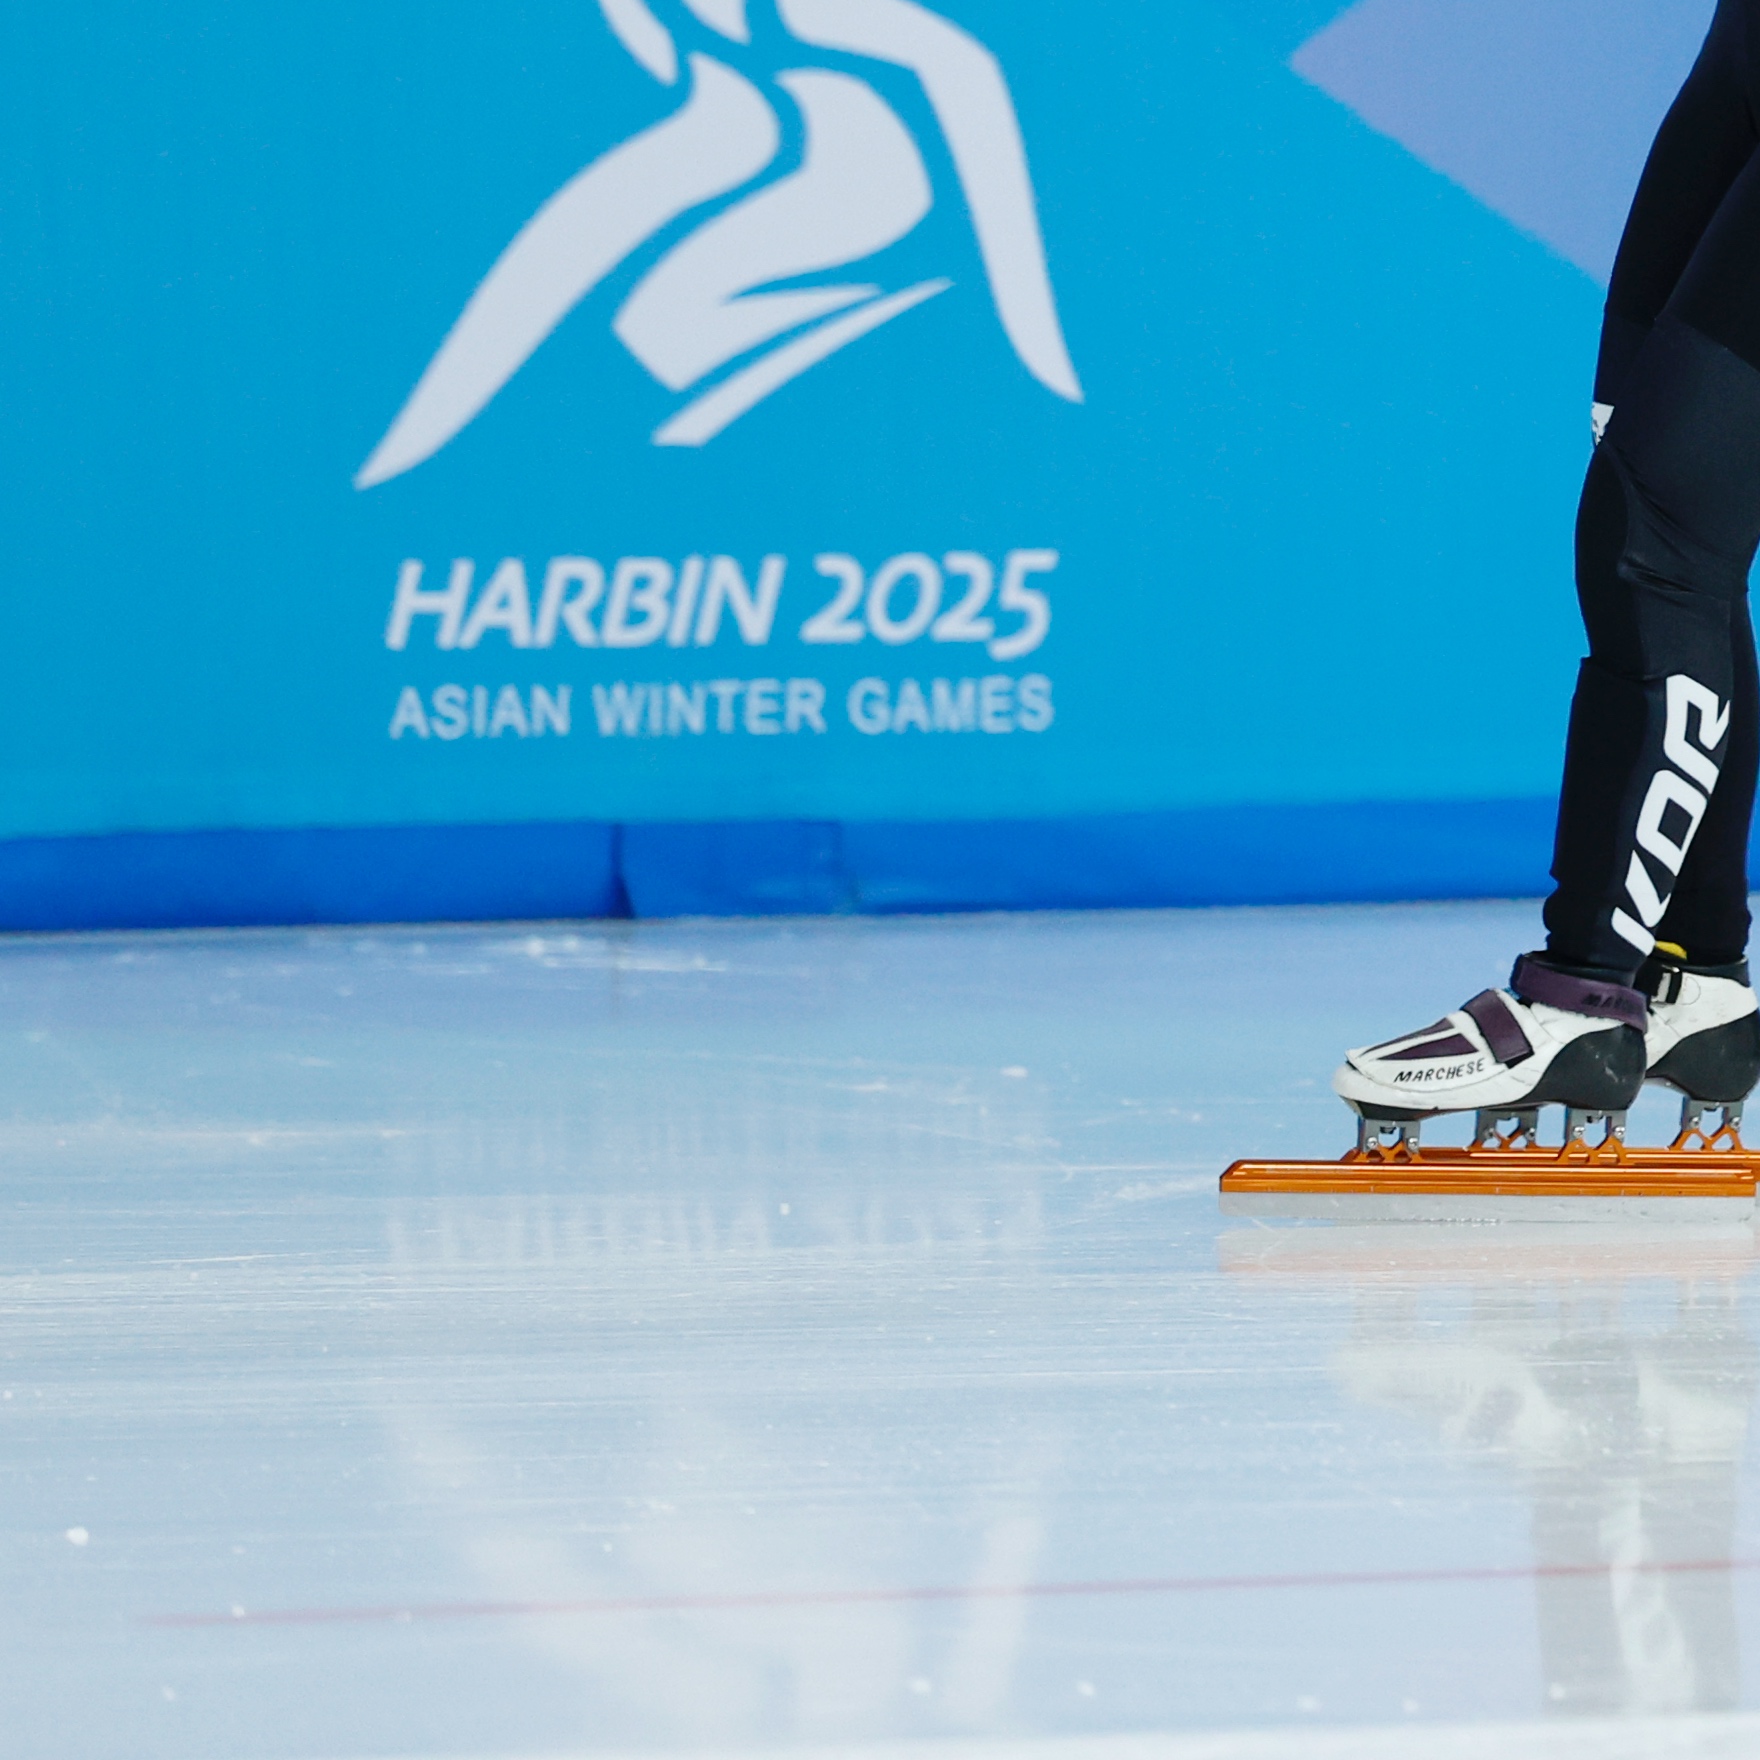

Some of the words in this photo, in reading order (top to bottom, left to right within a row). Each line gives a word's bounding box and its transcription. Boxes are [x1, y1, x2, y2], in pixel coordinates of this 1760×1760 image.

[385, 555, 787, 649] HARBIN
[800, 550, 1058, 661] 2025
[390, 684, 571, 739] ASIAN
[593, 679, 827, 737] WINTER
[849, 675, 1053, 734] GAMES
[1611, 674, 1730, 956] KOR
[1393, 1057, 1485, 1083] MARCHESE
